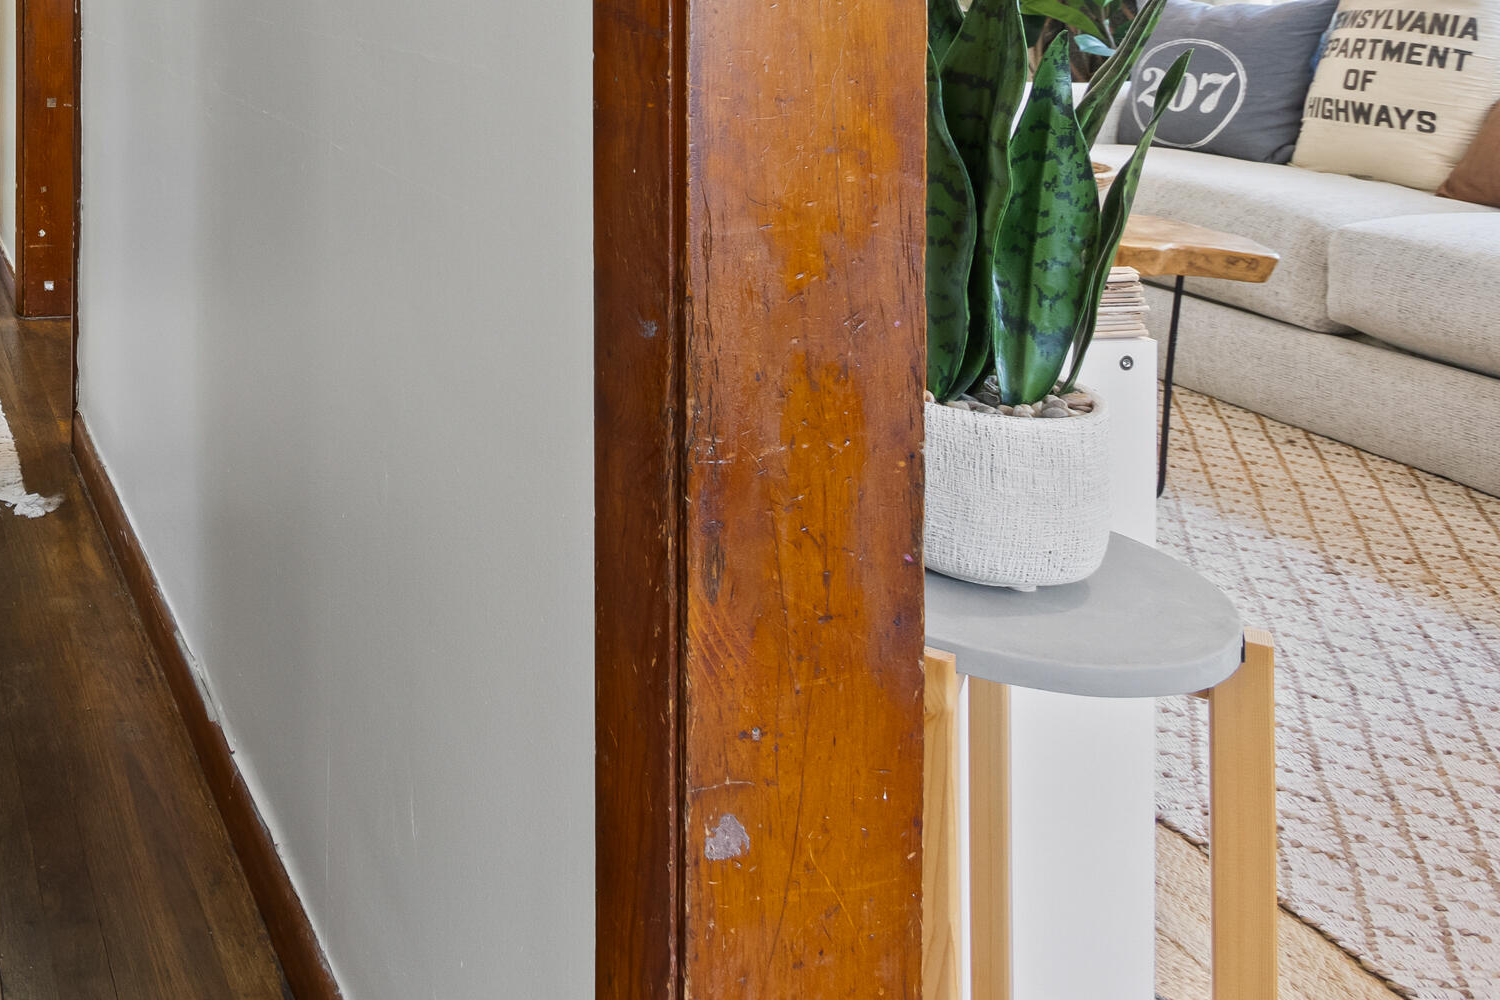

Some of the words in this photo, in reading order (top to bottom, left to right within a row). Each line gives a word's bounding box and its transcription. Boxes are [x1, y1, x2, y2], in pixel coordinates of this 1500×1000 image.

[1137, 67, 1237, 114] 207
[1343, 68, 1377, 92] OF
[1308, 96, 1437, 134] HIGHWAYS
